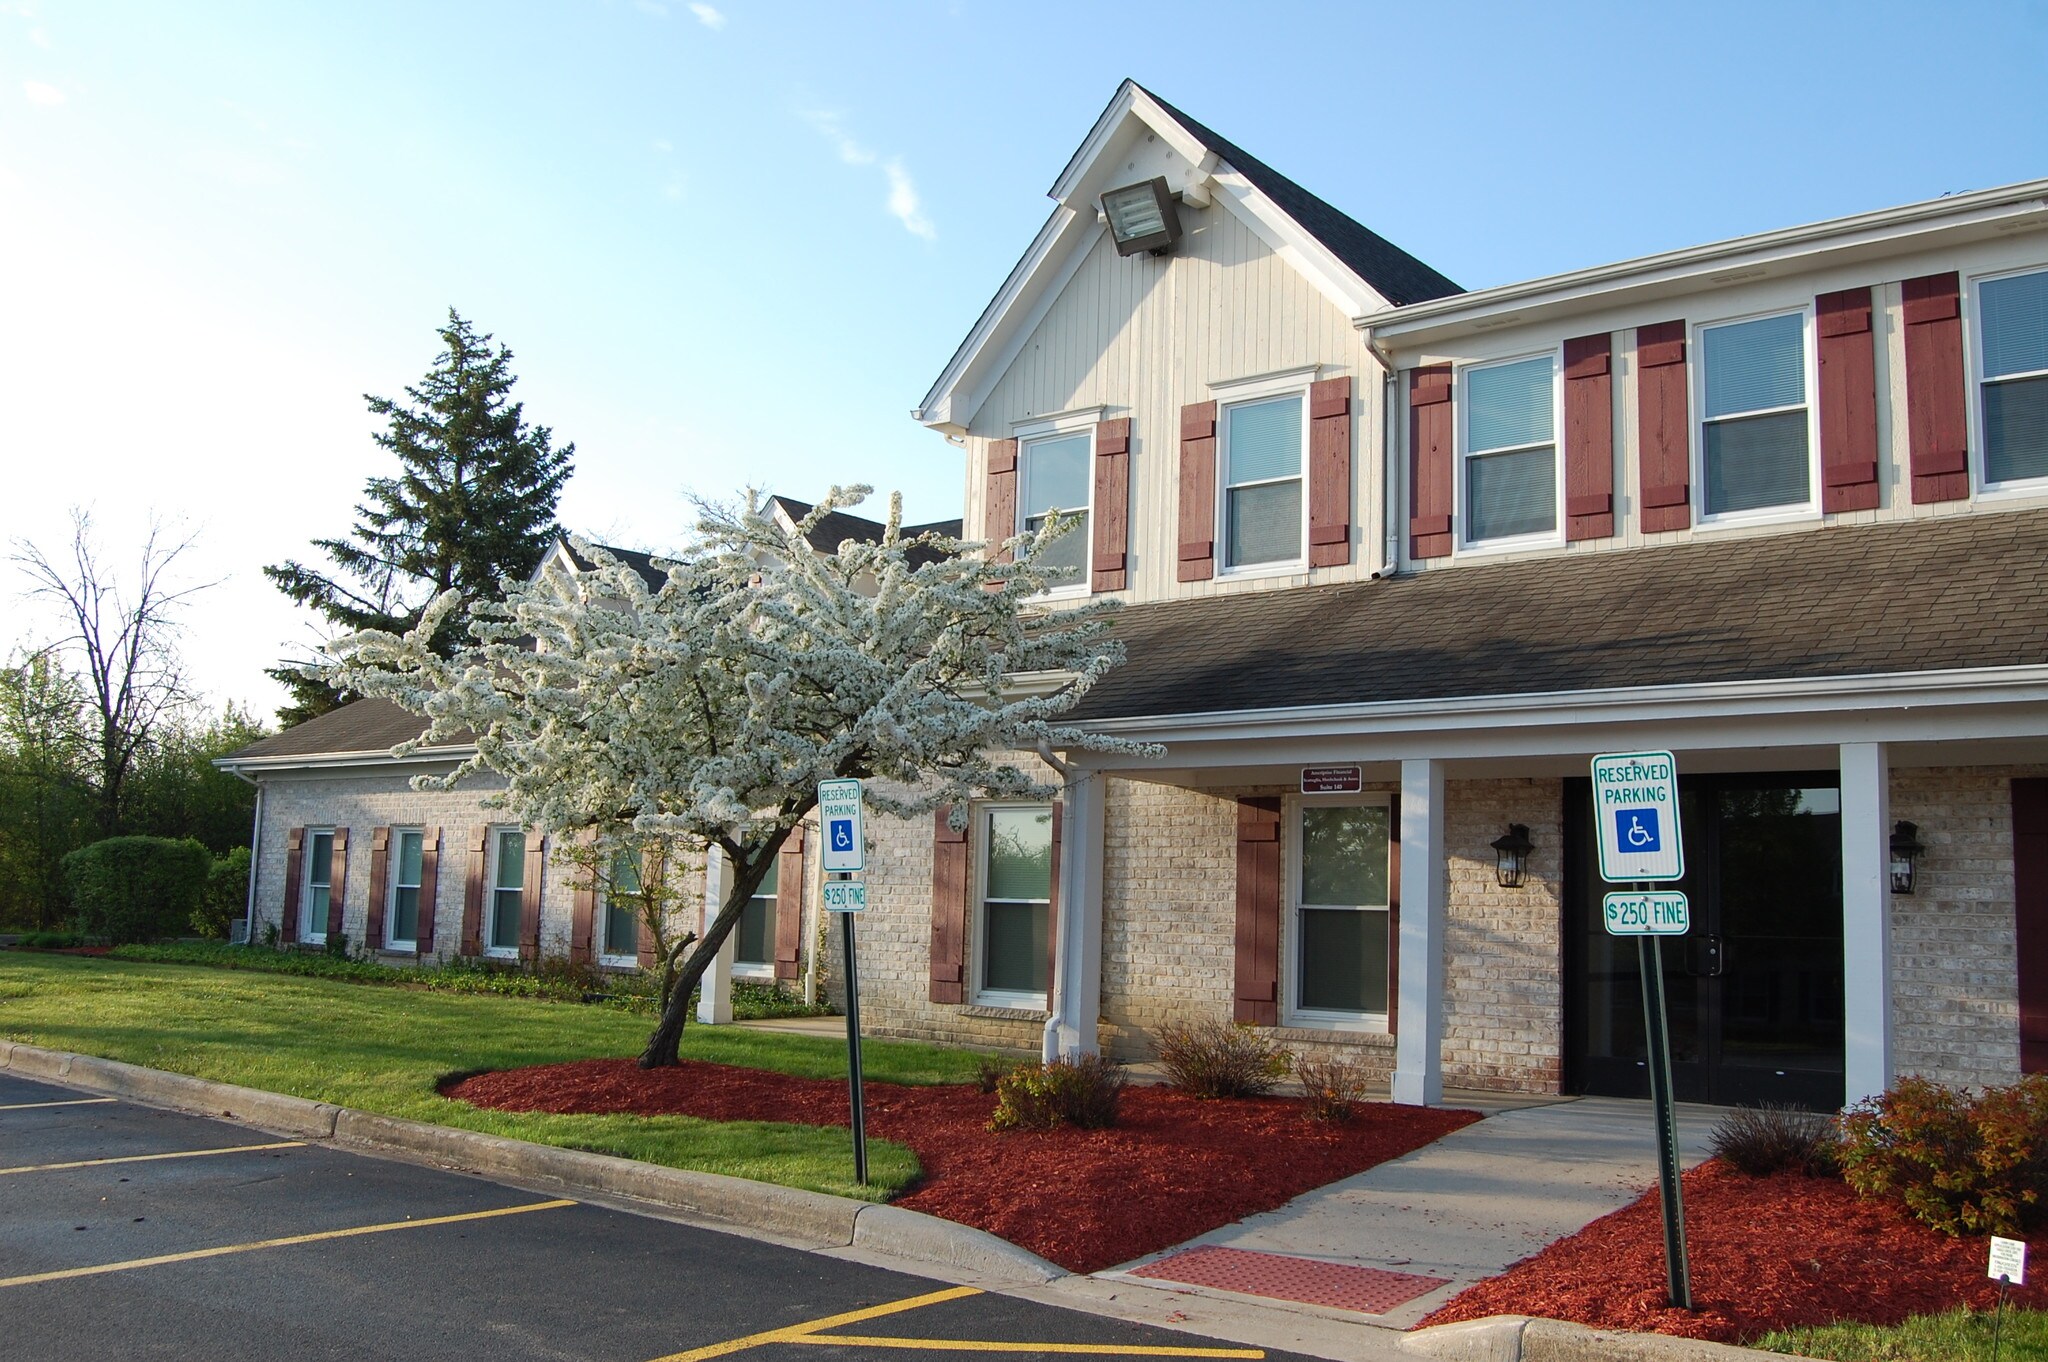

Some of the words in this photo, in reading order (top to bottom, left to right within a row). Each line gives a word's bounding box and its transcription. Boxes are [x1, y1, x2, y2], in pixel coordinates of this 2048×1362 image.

[1599, 764, 1669, 783] RESERVED
[821, 788, 858, 801] RESERVED
[1605, 786, 1666, 804] PARKING
[824, 804, 856, 816] PARKING
[849, 887, 865, 905] FINE
[1654, 901, 1685, 924] FINE
